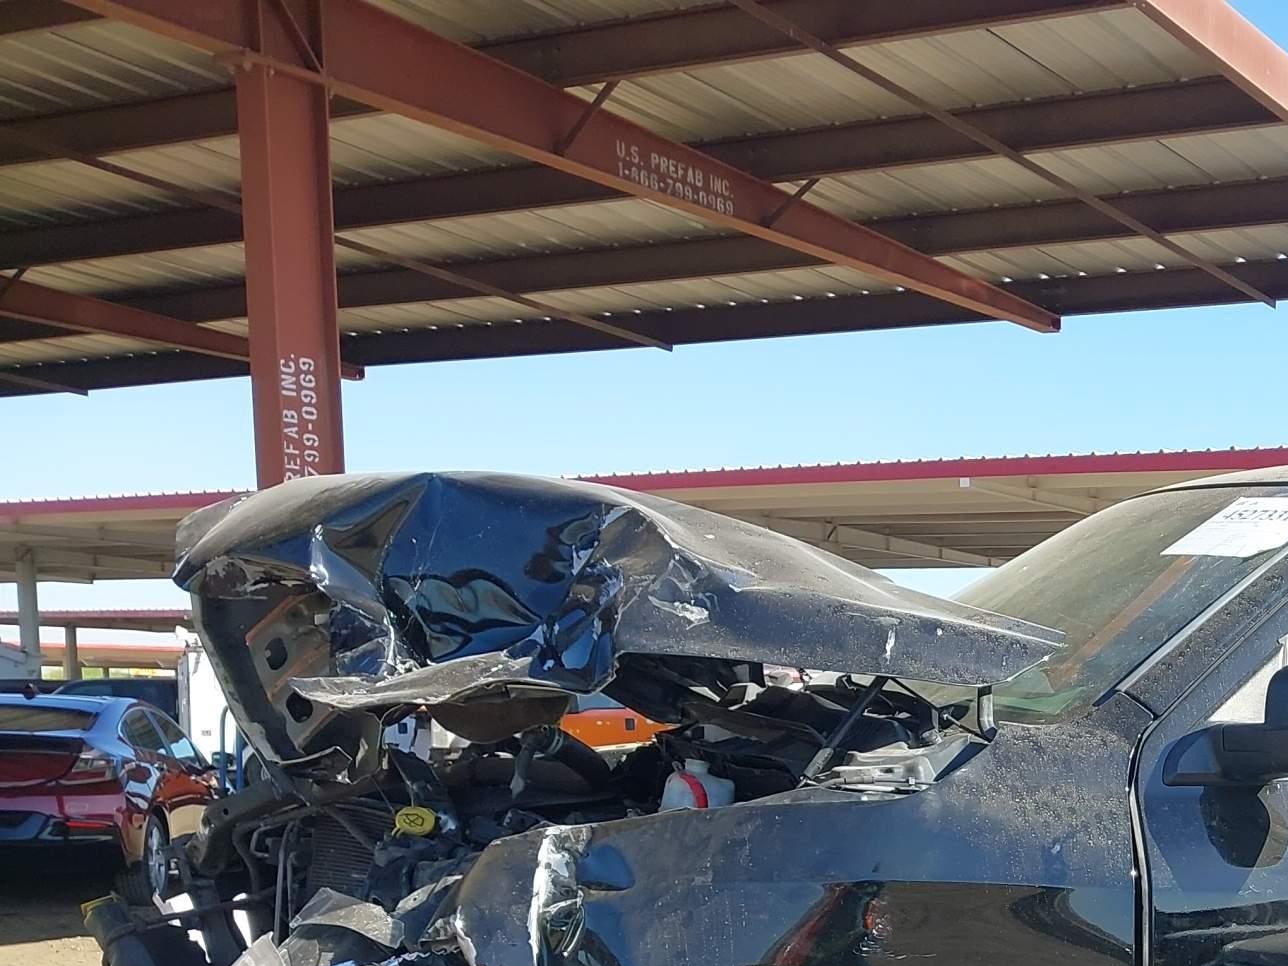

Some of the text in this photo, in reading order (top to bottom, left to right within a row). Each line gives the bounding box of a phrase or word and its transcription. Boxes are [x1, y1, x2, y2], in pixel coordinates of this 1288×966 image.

[616, 139, 735, 198] U.S. PREFAB INC.
[280, 353, 297, 396] INC.
